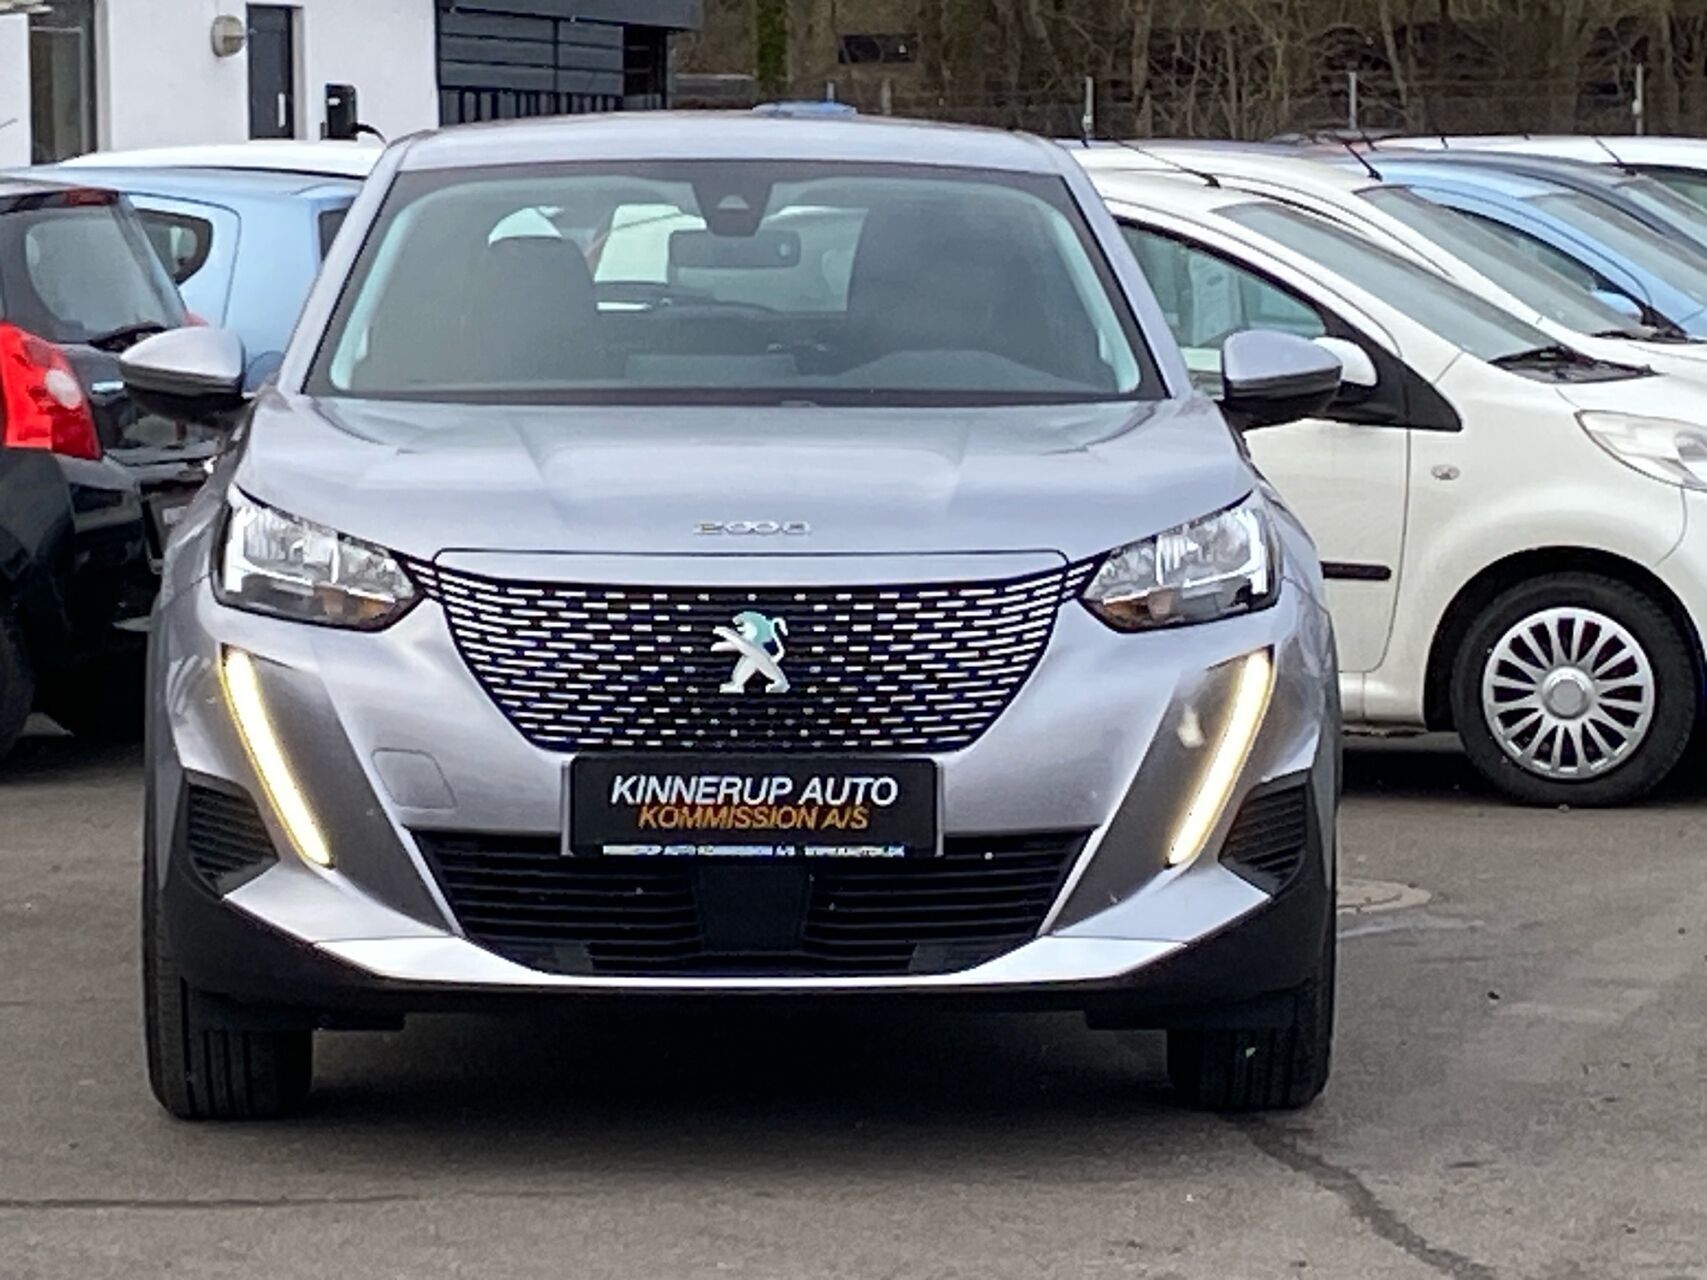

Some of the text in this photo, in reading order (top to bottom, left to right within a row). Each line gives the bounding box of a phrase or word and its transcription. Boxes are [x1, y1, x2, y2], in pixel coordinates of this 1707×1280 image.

[611, 775, 898, 806] KINNERUP AUTO
[638, 807, 870, 830] KOMMISSION A/S
